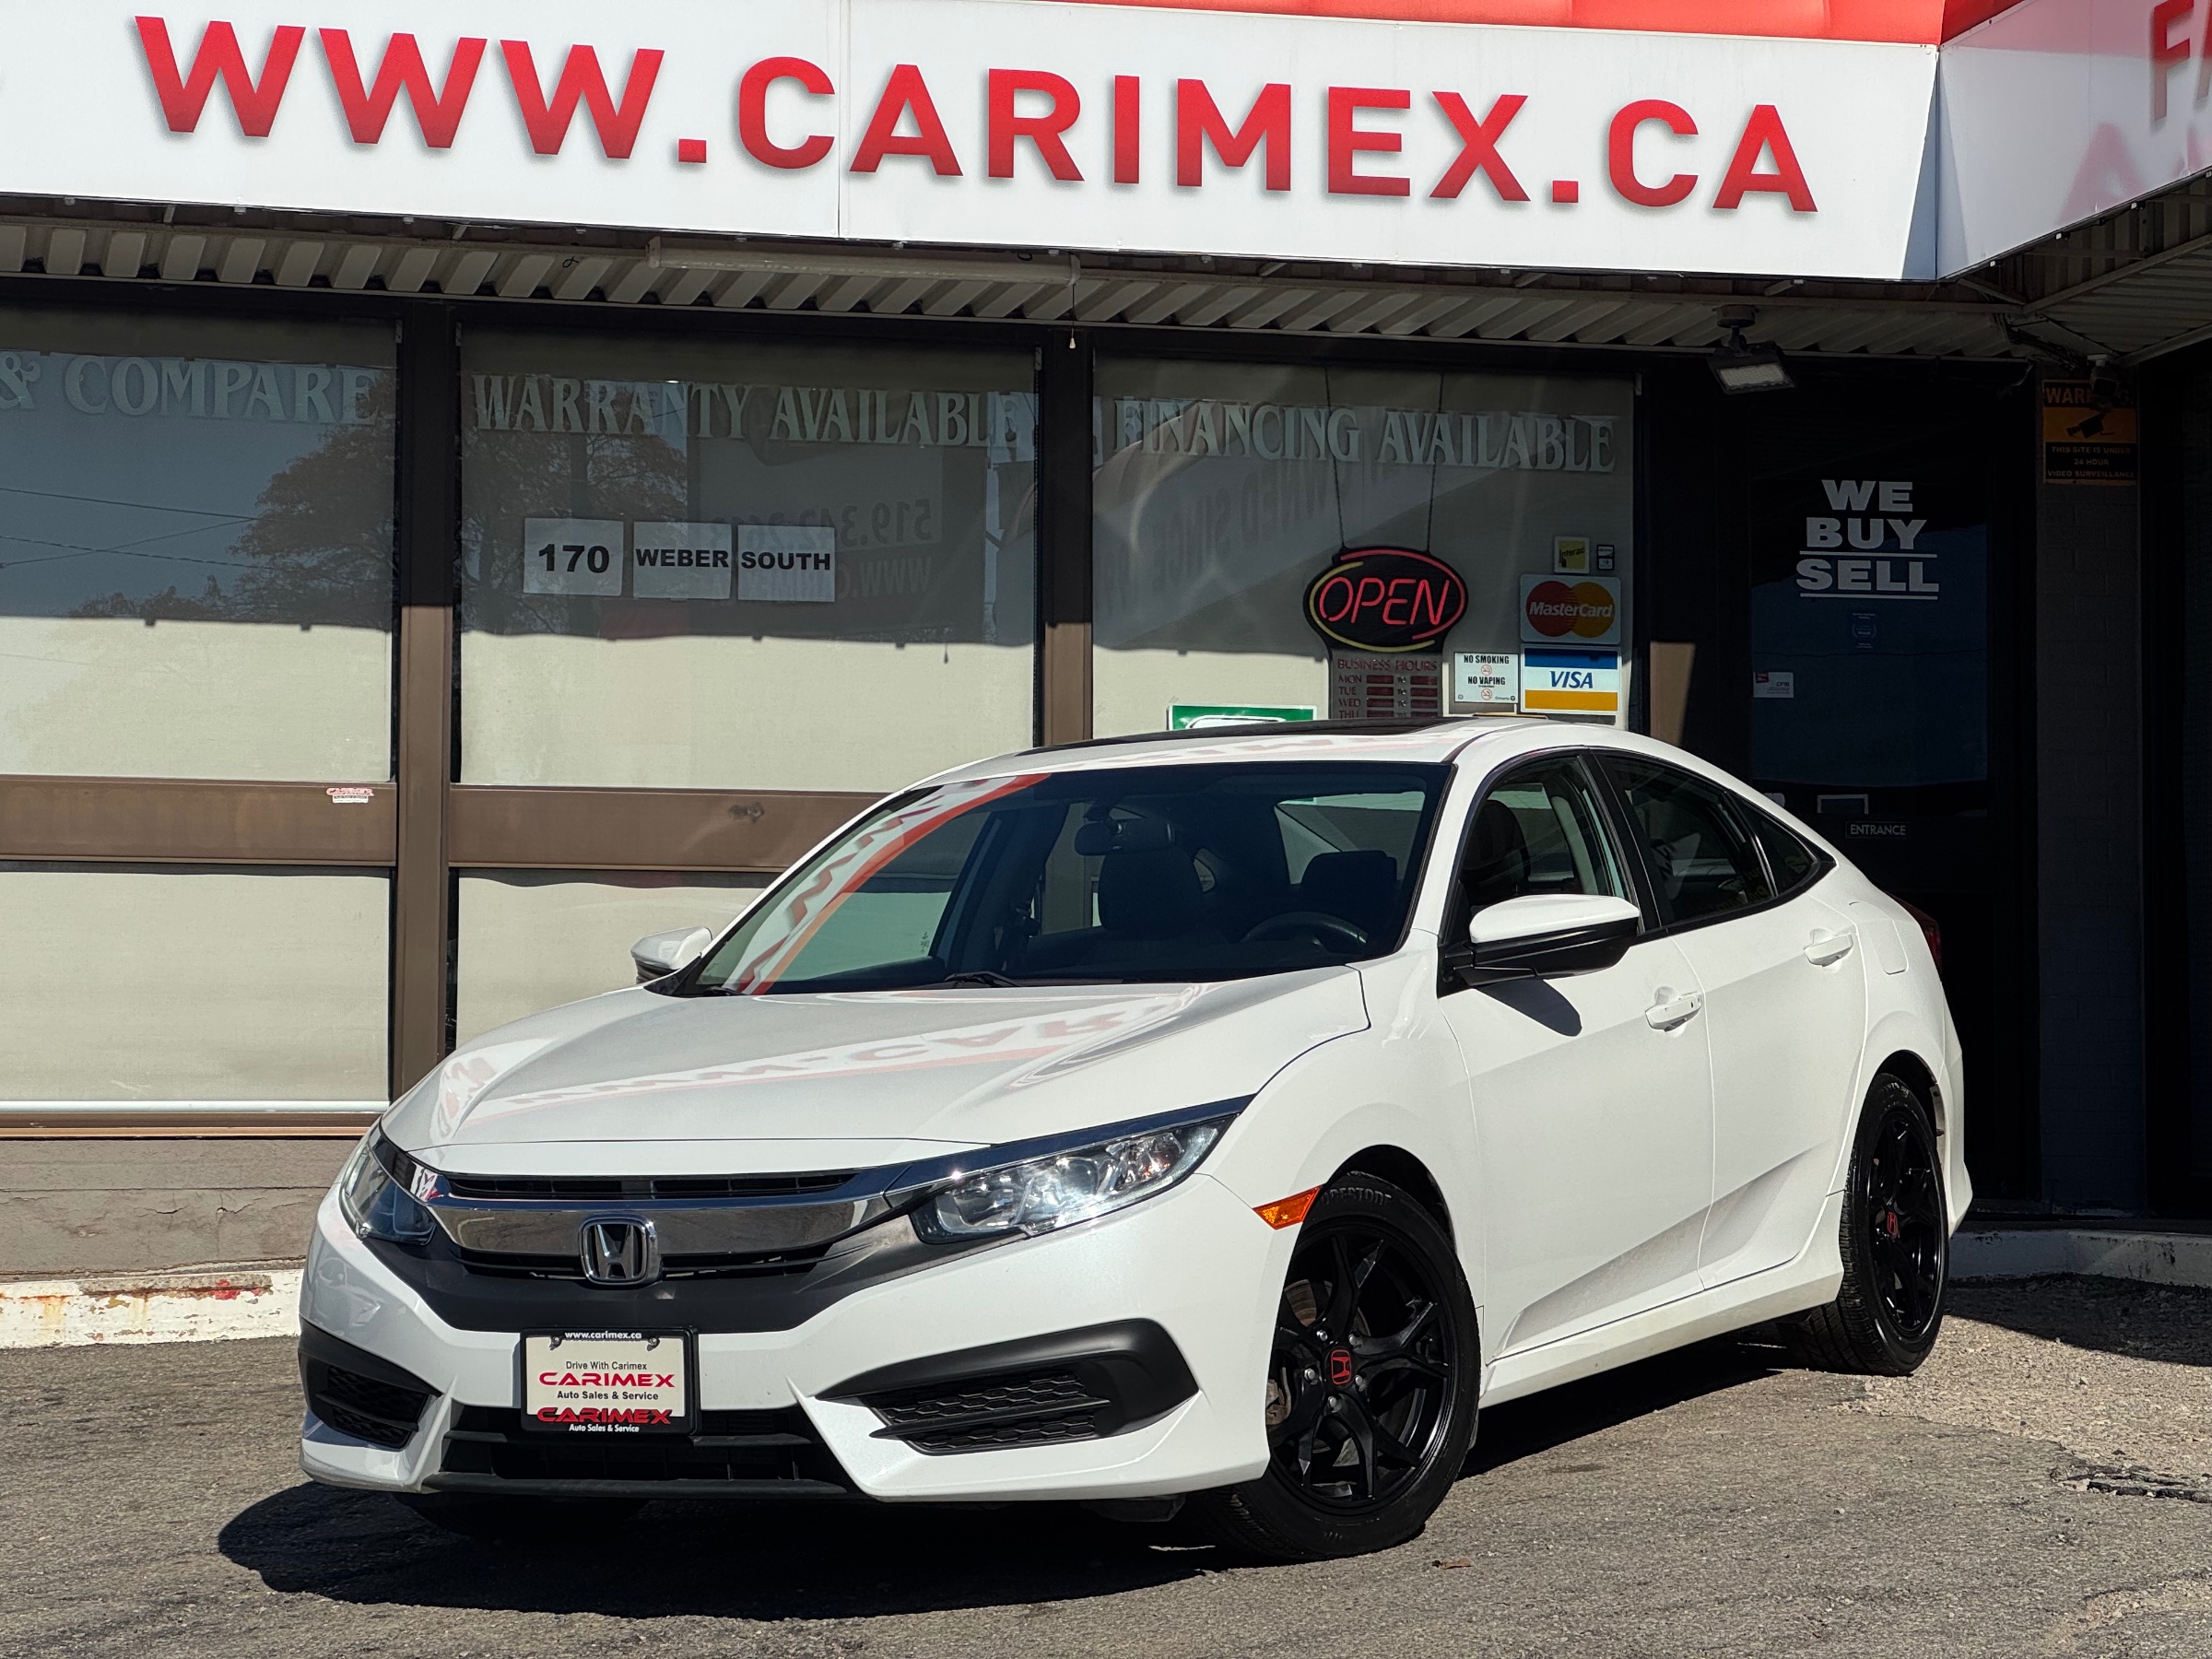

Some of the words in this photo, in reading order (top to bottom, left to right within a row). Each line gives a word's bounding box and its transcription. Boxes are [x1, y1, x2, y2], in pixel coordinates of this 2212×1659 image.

[135, 16, 1818, 212] WWW.CARIMEX.CA
[0, 352, 41, 410] &
[64, 356, 380, 426] COMPARE
[471, 374, 752, 439] WARRANTY
[767, 386, 1020, 448] AVAILABLE
[1114, 399, 1360, 461] FINANCING
[1377, 411, 1615, 473] AVAILABLE
[2075, 470, 2136, 478] SURVEILLANCE
[1821, 479, 1912, 512] WE
[1806, 517, 1927, 549] BUY
[538, 544, 609, 573] 170
[635, 548, 729, 568] WEBER
[740, 551, 830, 571] SOUTH
[1796, 559, 1939, 592] SELL
[1319, 576, 1450, 625] OPEN
[1529, 602, 1613, 618] MasterCard
[1337, 658, 1391, 670] BUSINESS
[1395, 660, 1438, 671] HOURS
[1464, 655, 1474, 664] NO
[1476, 655, 1510, 665] SMOKING
[1338, 675, 1362, 683] MON
[1468, 677, 1477, 685] NO
[1479, 677, 1506, 685] VAPING
[1550, 670, 1594, 688] VISA
[1338, 687, 1357, 695] TUE
[1338, 699, 1361, 707] WED
[1850, 824, 1906, 836] ENTRANCE
[564, 1330, 642, 1340] www.carimex.ca
[566, 1361, 588, 1371] Drive
[590, 1361, 609, 1371] With
[611, 1361, 647, 1371] Carimex
[539, 1371, 675, 1387] CARIMEX
[557, 1391, 579, 1400] Auto
[582, 1391, 608, 1400] Sales
[612, 1392, 619, 1400] &
[622, 1392, 659, 1400] Service
[536, 1406, 673, 1424] CARIMEX
[569, 1423, 586, 1432] Auto
[587, 1424, 606, 1432] Sales
[607, 1424, 613, 1432] &
[614, 1424, 640, 1433] Service
